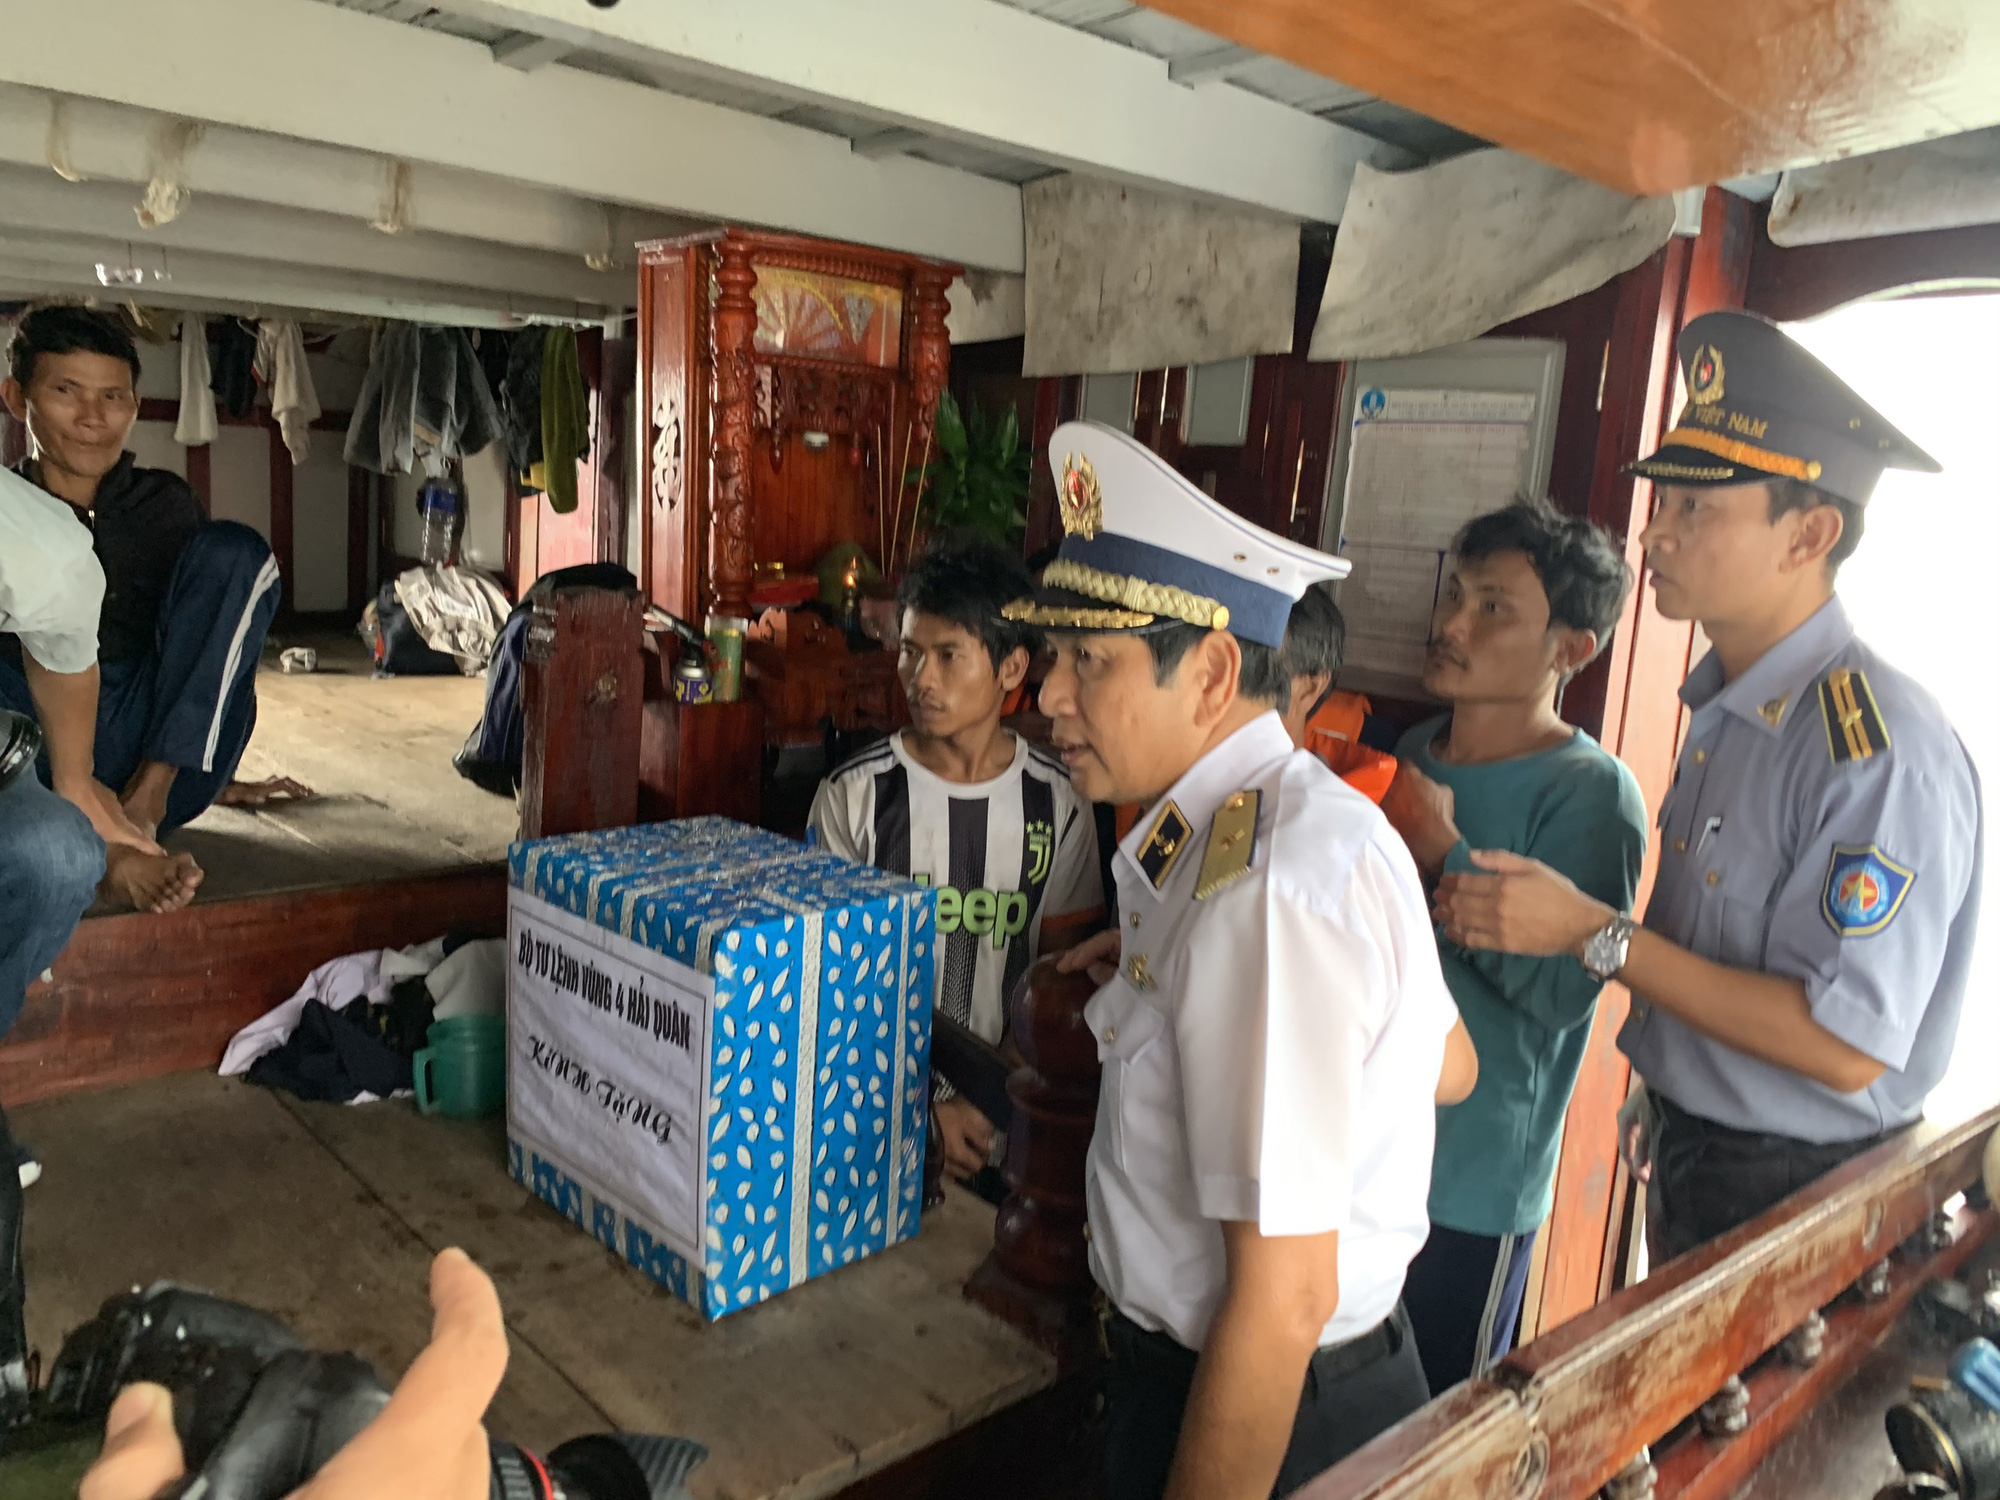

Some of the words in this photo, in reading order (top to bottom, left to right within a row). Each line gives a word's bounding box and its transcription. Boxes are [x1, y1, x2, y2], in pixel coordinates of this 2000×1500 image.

[1727, 411, 1769, 439] NAM
[913, 873, 1028, 949] eep
[518, 927, 534, 976] BỘ
[550, 943, 580, 996] LỆNH
[581, 958, 612, 1013] VÙNG
[615, 981, 624, 1018] 4
[626, 974, 650, 1031] HẢI
[653, 998, 690, 1052] QUÂN
